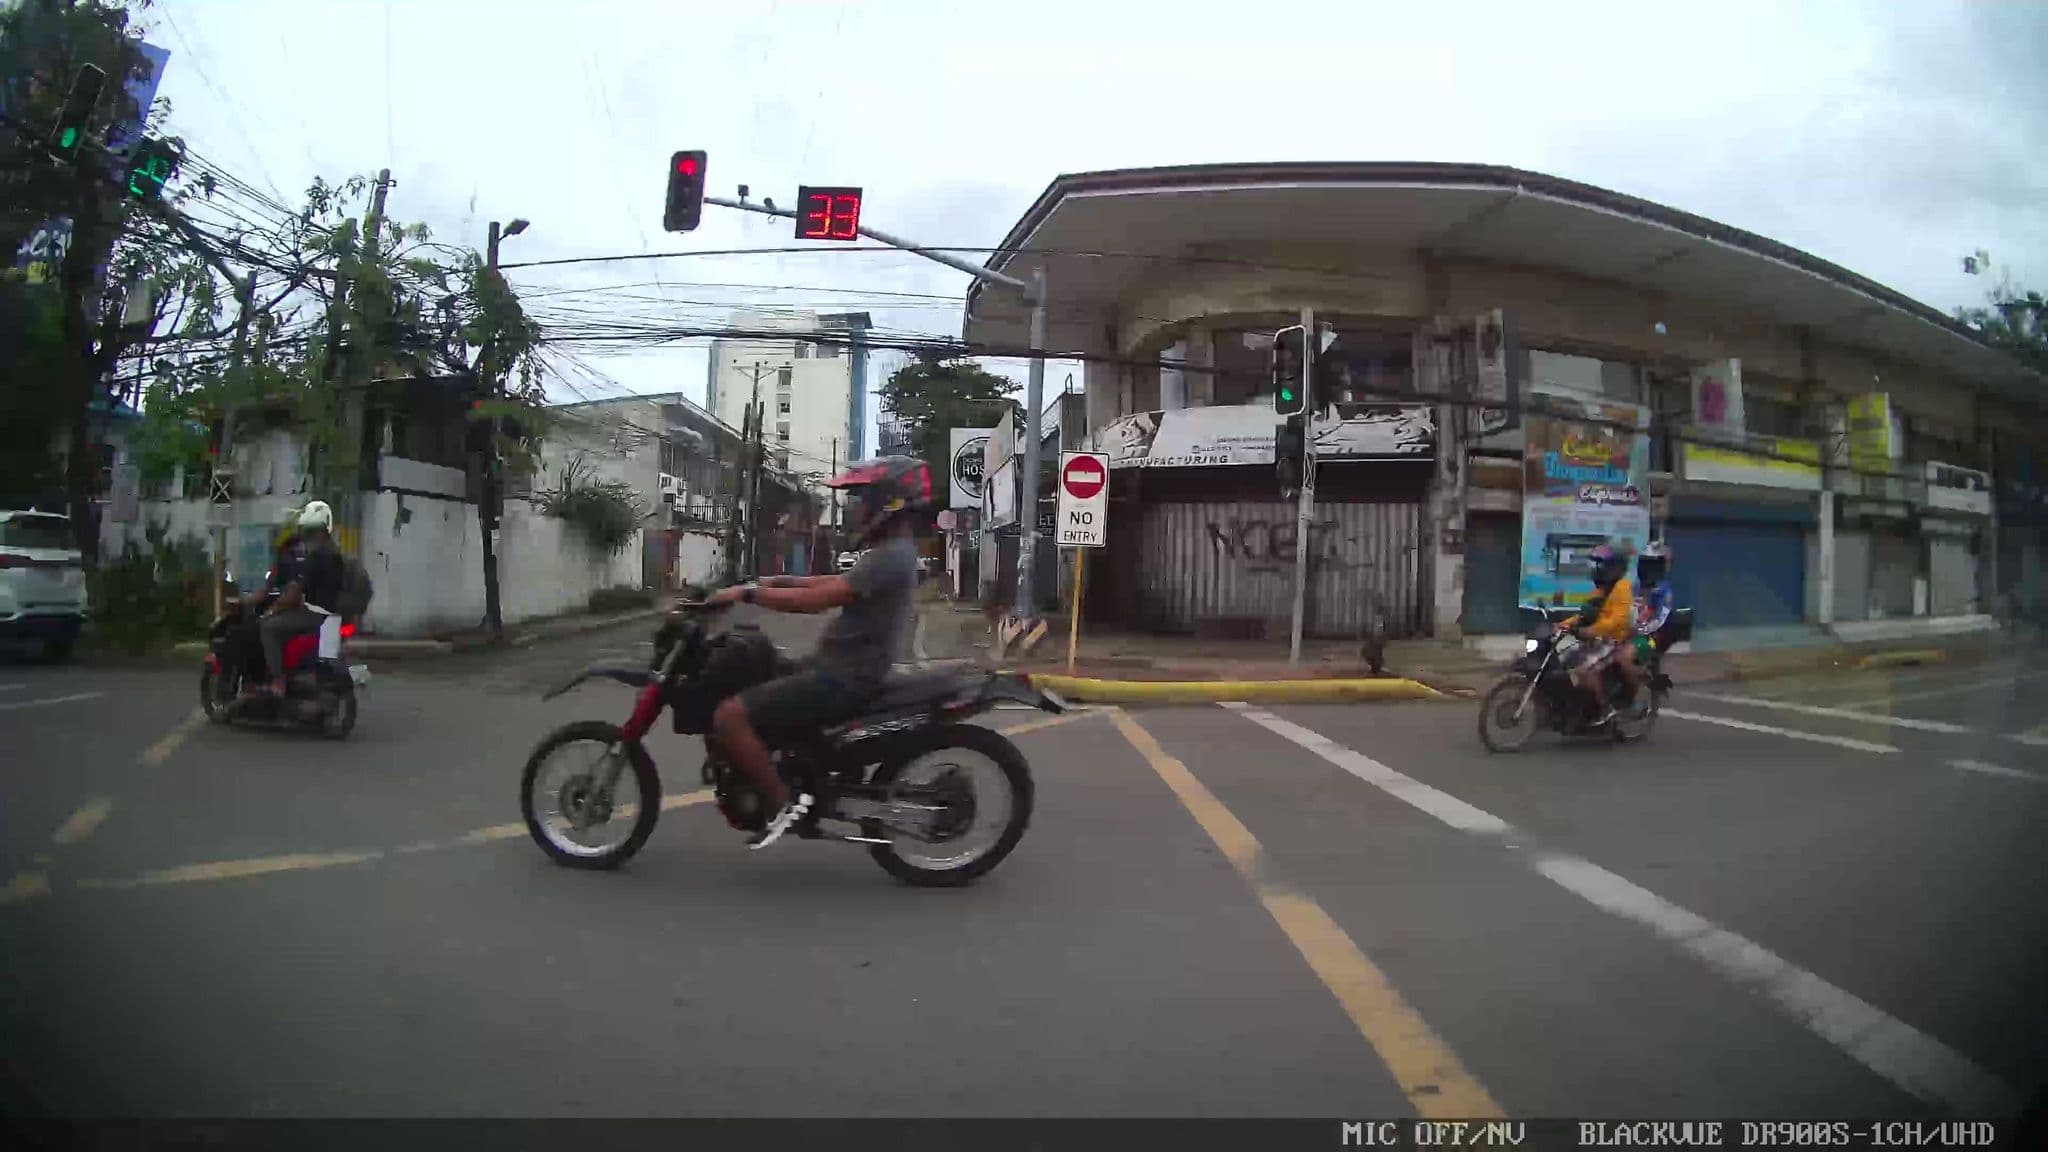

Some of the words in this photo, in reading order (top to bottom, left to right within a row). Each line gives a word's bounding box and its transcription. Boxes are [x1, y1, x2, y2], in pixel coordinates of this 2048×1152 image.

[805, 194, 859, 237] 33
[1070, 511, 1093, 525] NO
[1063, 530, 1098, 543] ENTRY
